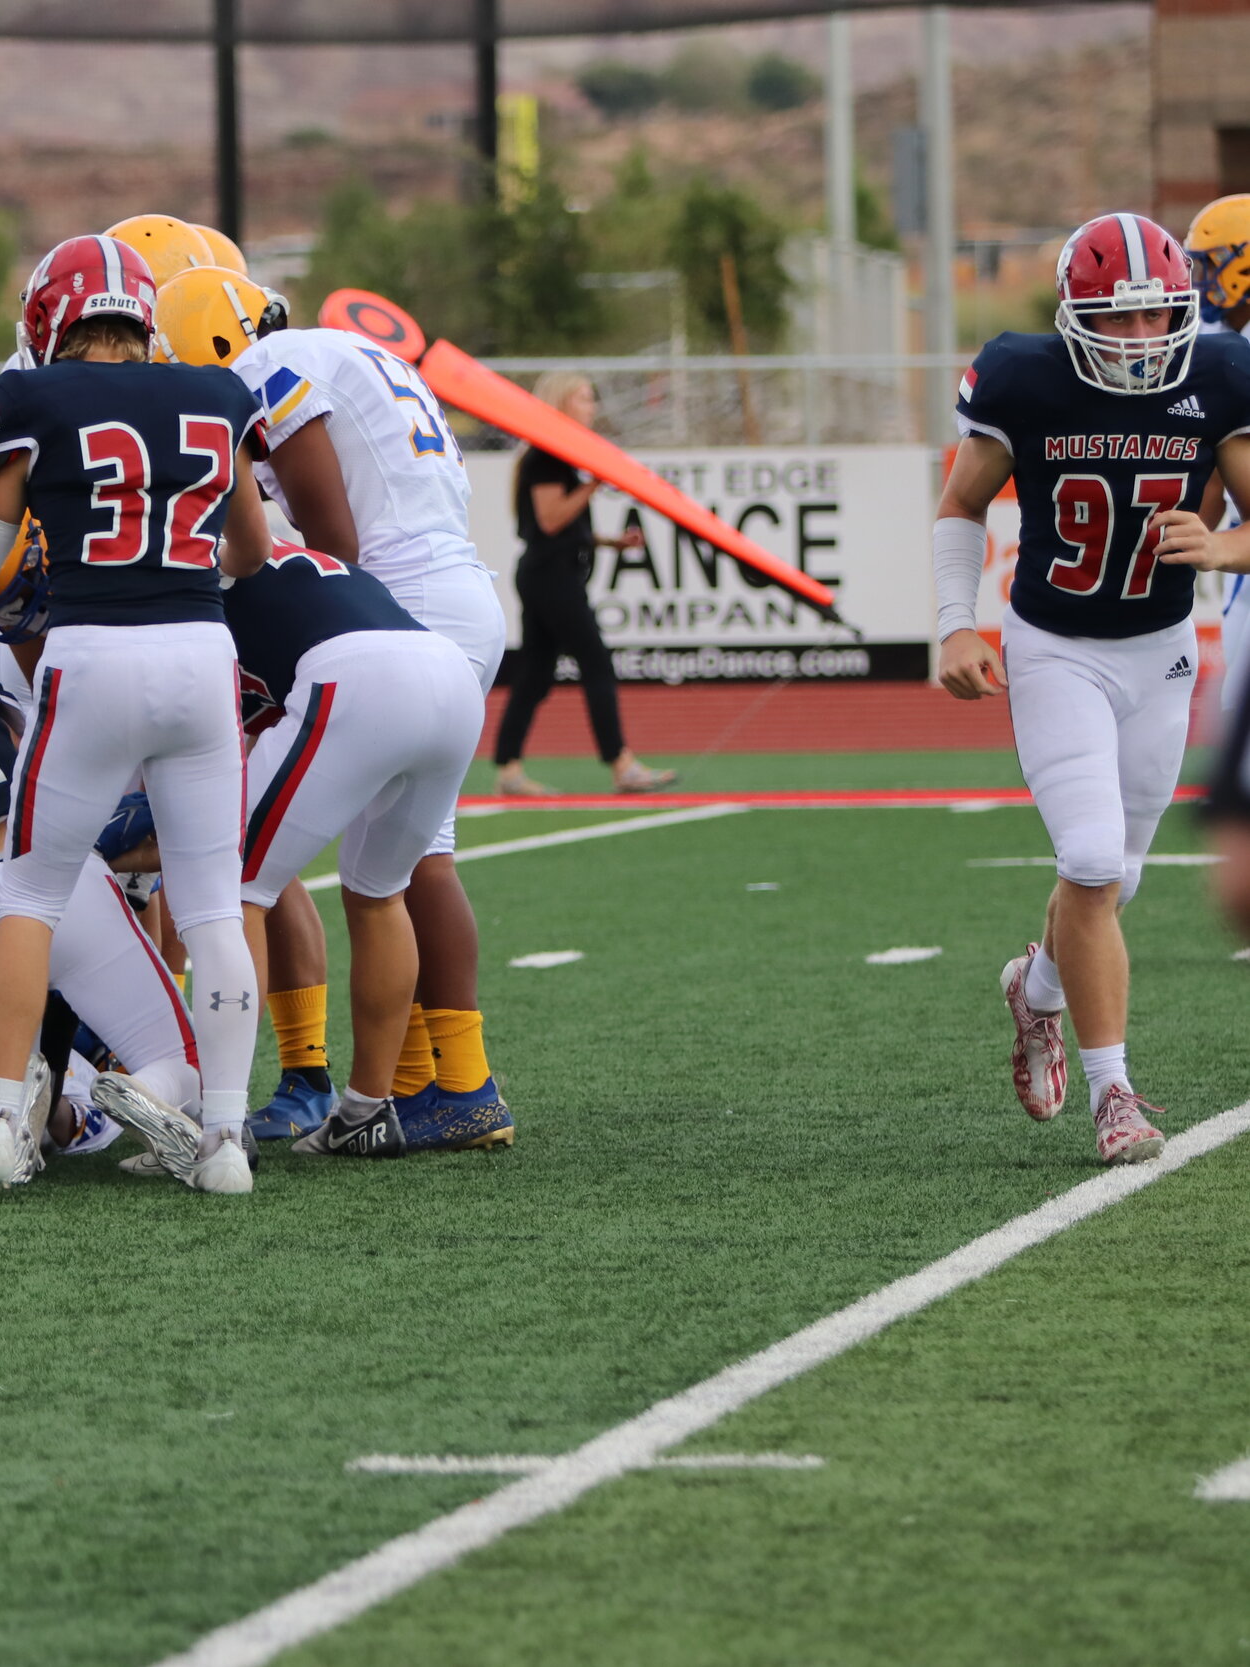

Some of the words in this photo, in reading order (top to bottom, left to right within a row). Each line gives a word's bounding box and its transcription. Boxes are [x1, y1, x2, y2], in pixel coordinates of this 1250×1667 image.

[90, 296, 137, 310] schutt
[1167, 404, 1206, 419] adidas
[1045, 434, 1202, 461] MUSTANGS
[78, 414, 234, 570] 32
[724, 460, 839, 496] EDGE
[588, 503, 841, 591] ANCE
[1046, 472, 1189, 600] 97
[596, 600, 835, 633] OMPAN
[1164, 669, 1192, 681] adidas
